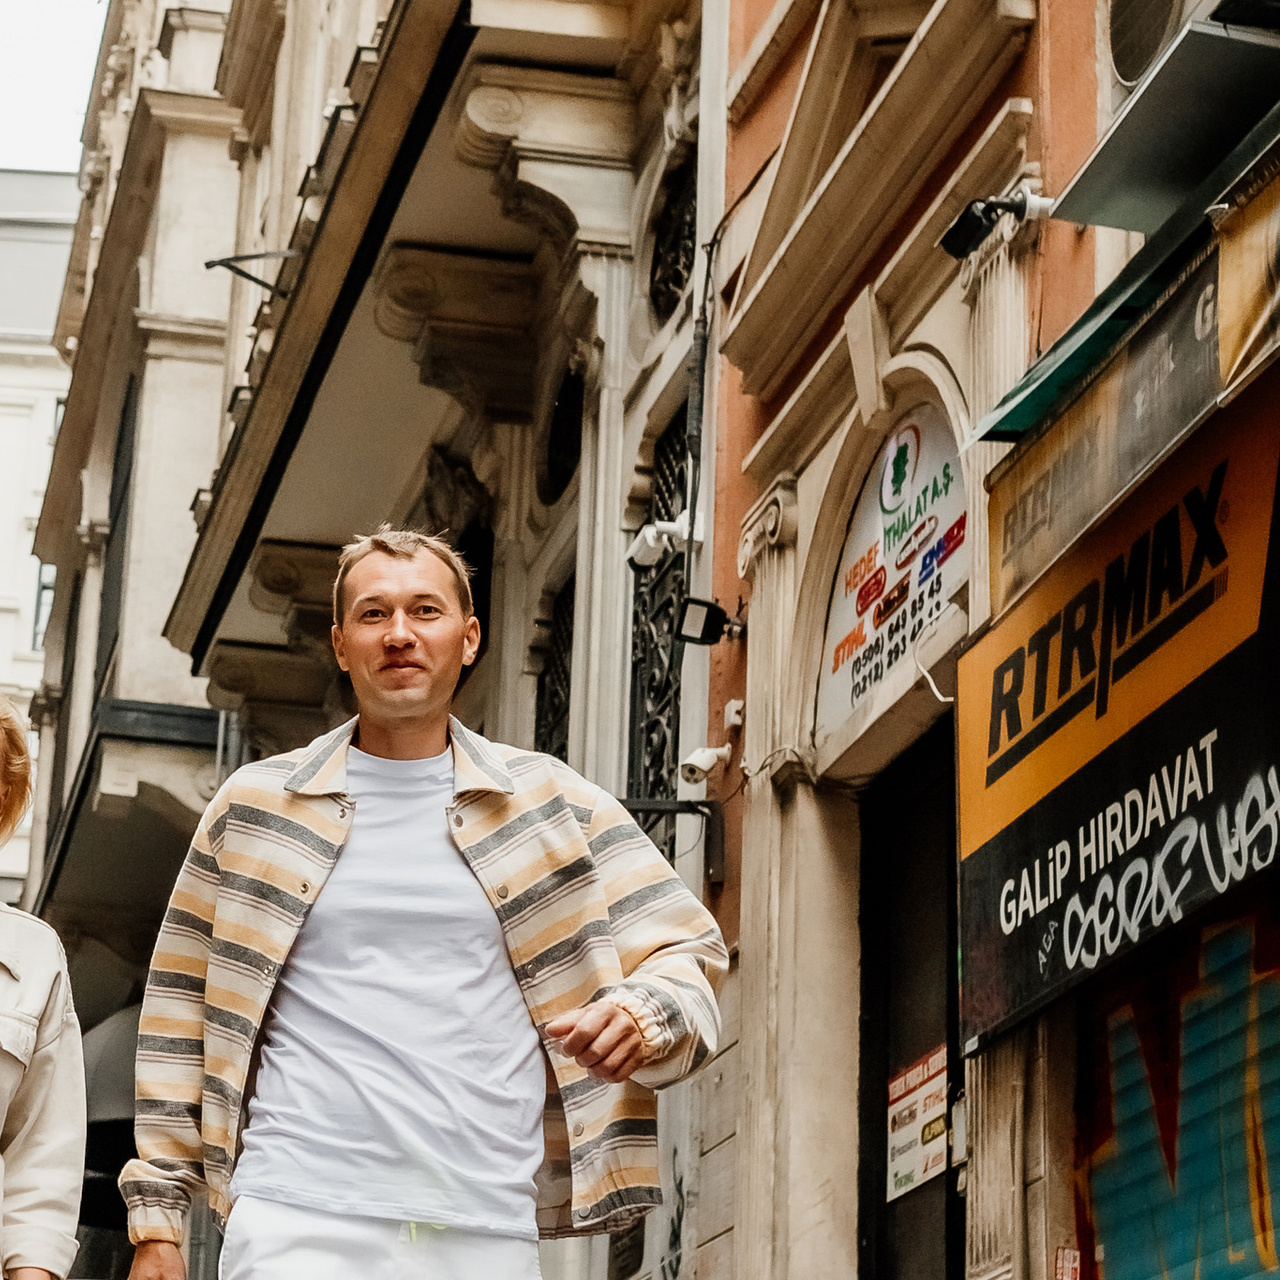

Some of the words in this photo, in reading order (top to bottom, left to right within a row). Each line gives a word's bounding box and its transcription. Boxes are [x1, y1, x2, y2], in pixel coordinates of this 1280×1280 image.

[845, 538, 880, 598] HEDEF
[987, 458, 1229, 760] RTRMAX
[1078, 728, 1218, 882] HIRDAVAT
